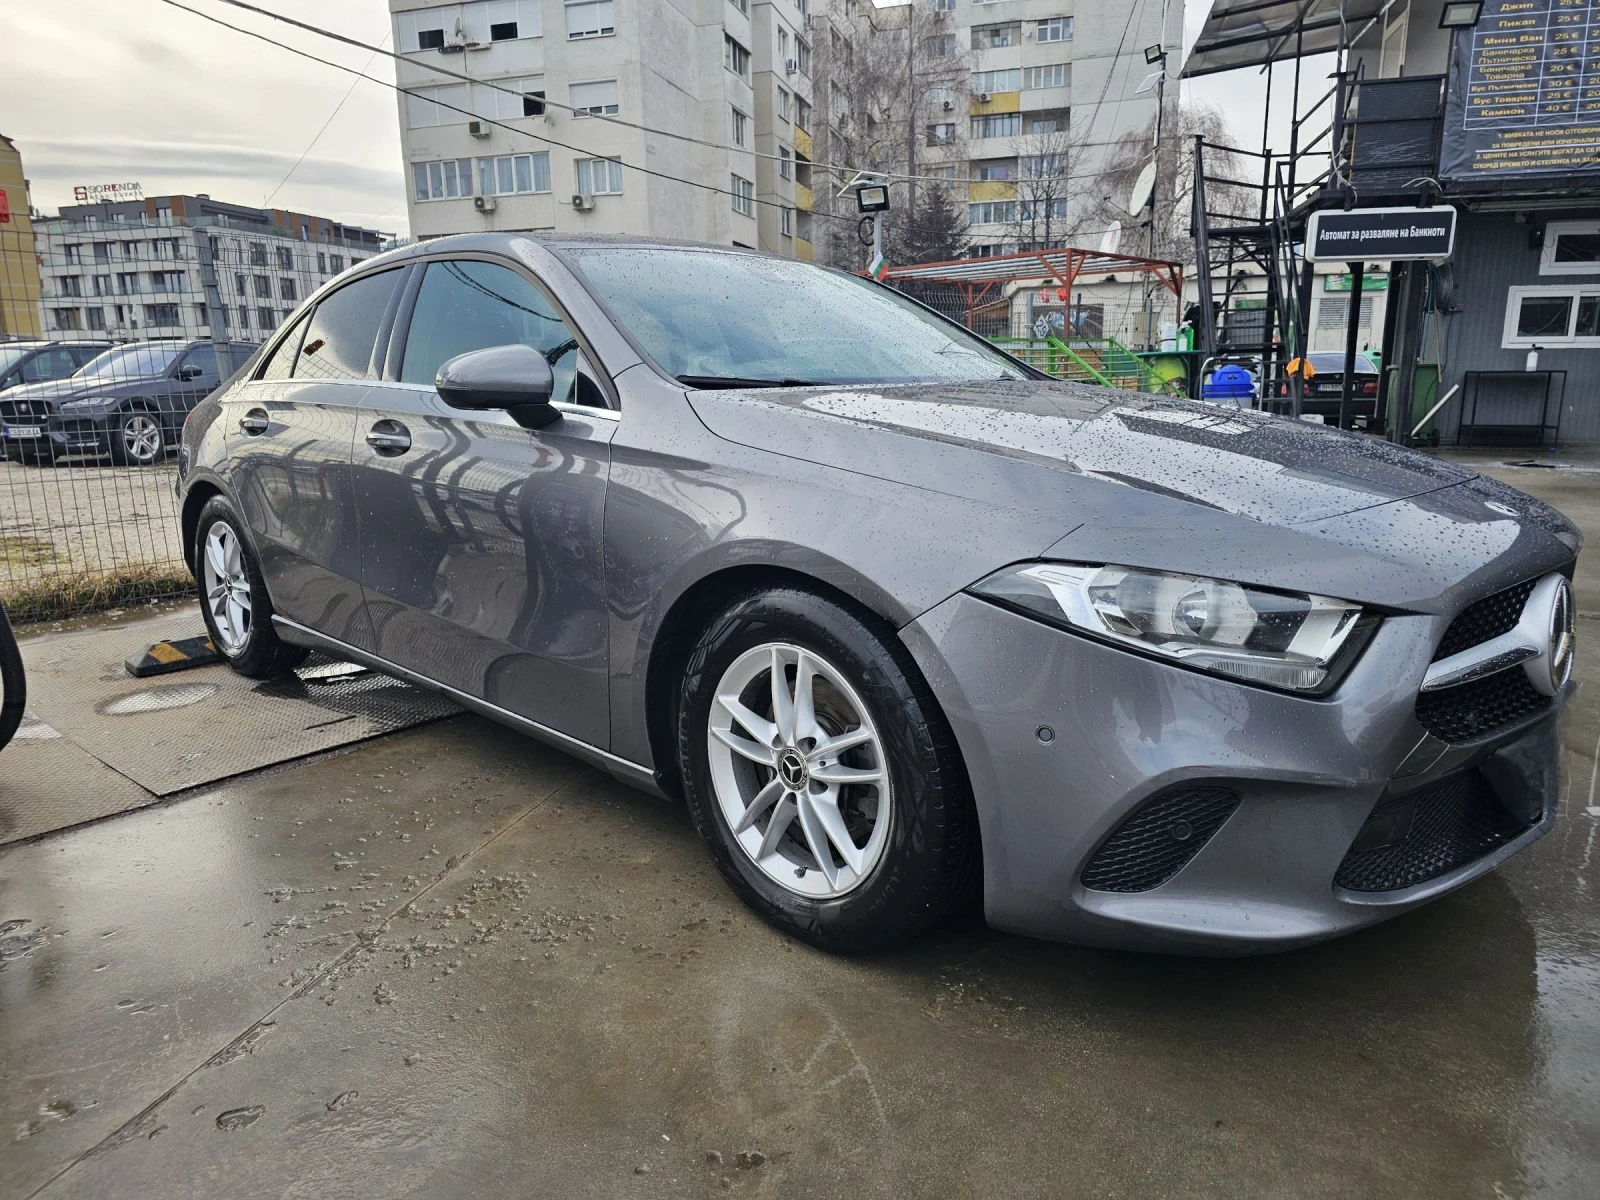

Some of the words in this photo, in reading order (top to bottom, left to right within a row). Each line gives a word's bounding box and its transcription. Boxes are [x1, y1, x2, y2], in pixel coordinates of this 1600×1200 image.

[1500, 3, 1534, 11] Джип
[1482, 48, 1534, 56] Баничарка
[1478, 55, 1536, 64] Пътническа
[1480, 64, 1532, 73] Баничарка
[1494, 95, 1535, 104] Товарен
[88, 182, 142, 193] SORENDA
[1320, 229, 1350, 240] Автомат
[1351, 231, 1359, 240] за
[1360, 229, 1399, 241] разваляне
[1400, 228, 1409, 237] на
[1410, 226, 1445, 237] Банкноти
